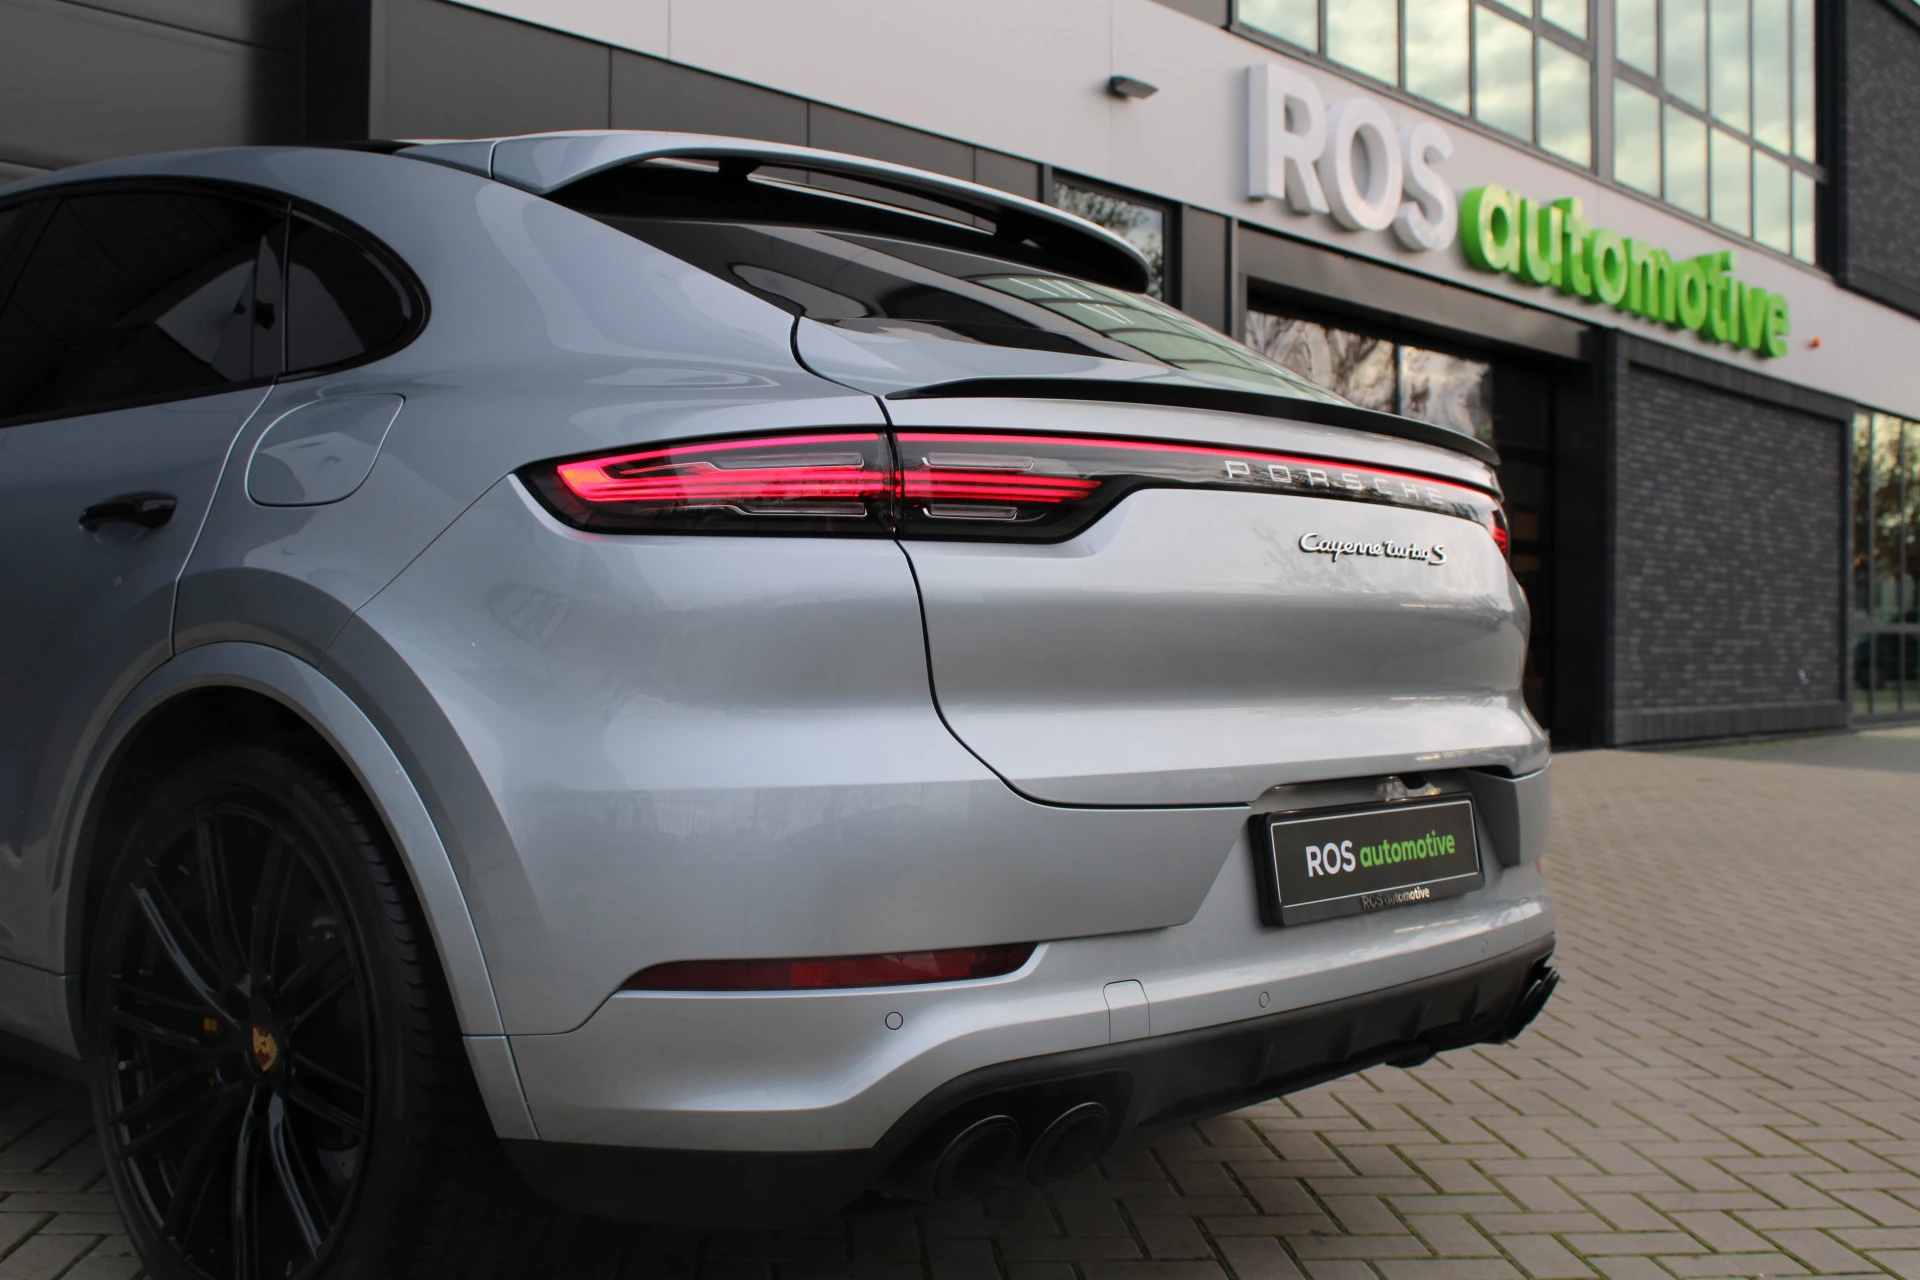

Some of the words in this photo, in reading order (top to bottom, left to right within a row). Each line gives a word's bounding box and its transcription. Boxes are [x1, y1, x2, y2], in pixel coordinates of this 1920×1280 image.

[1247, 62, 1459, 252] ROS
[1461, 183, 1790, 359] automotive
[1224, 459, 1446, 506] PORSCHE
[1298, 531, 1383, 563] Cayenne
[1428, 543, 1448, 566] S
[1305, 840, 1356, 877] ROS
[1360, 830, 1455, 868] automotive
[1361, 894, 1383, 910] ROS
[1384, 886, 1430, 905] automotive
